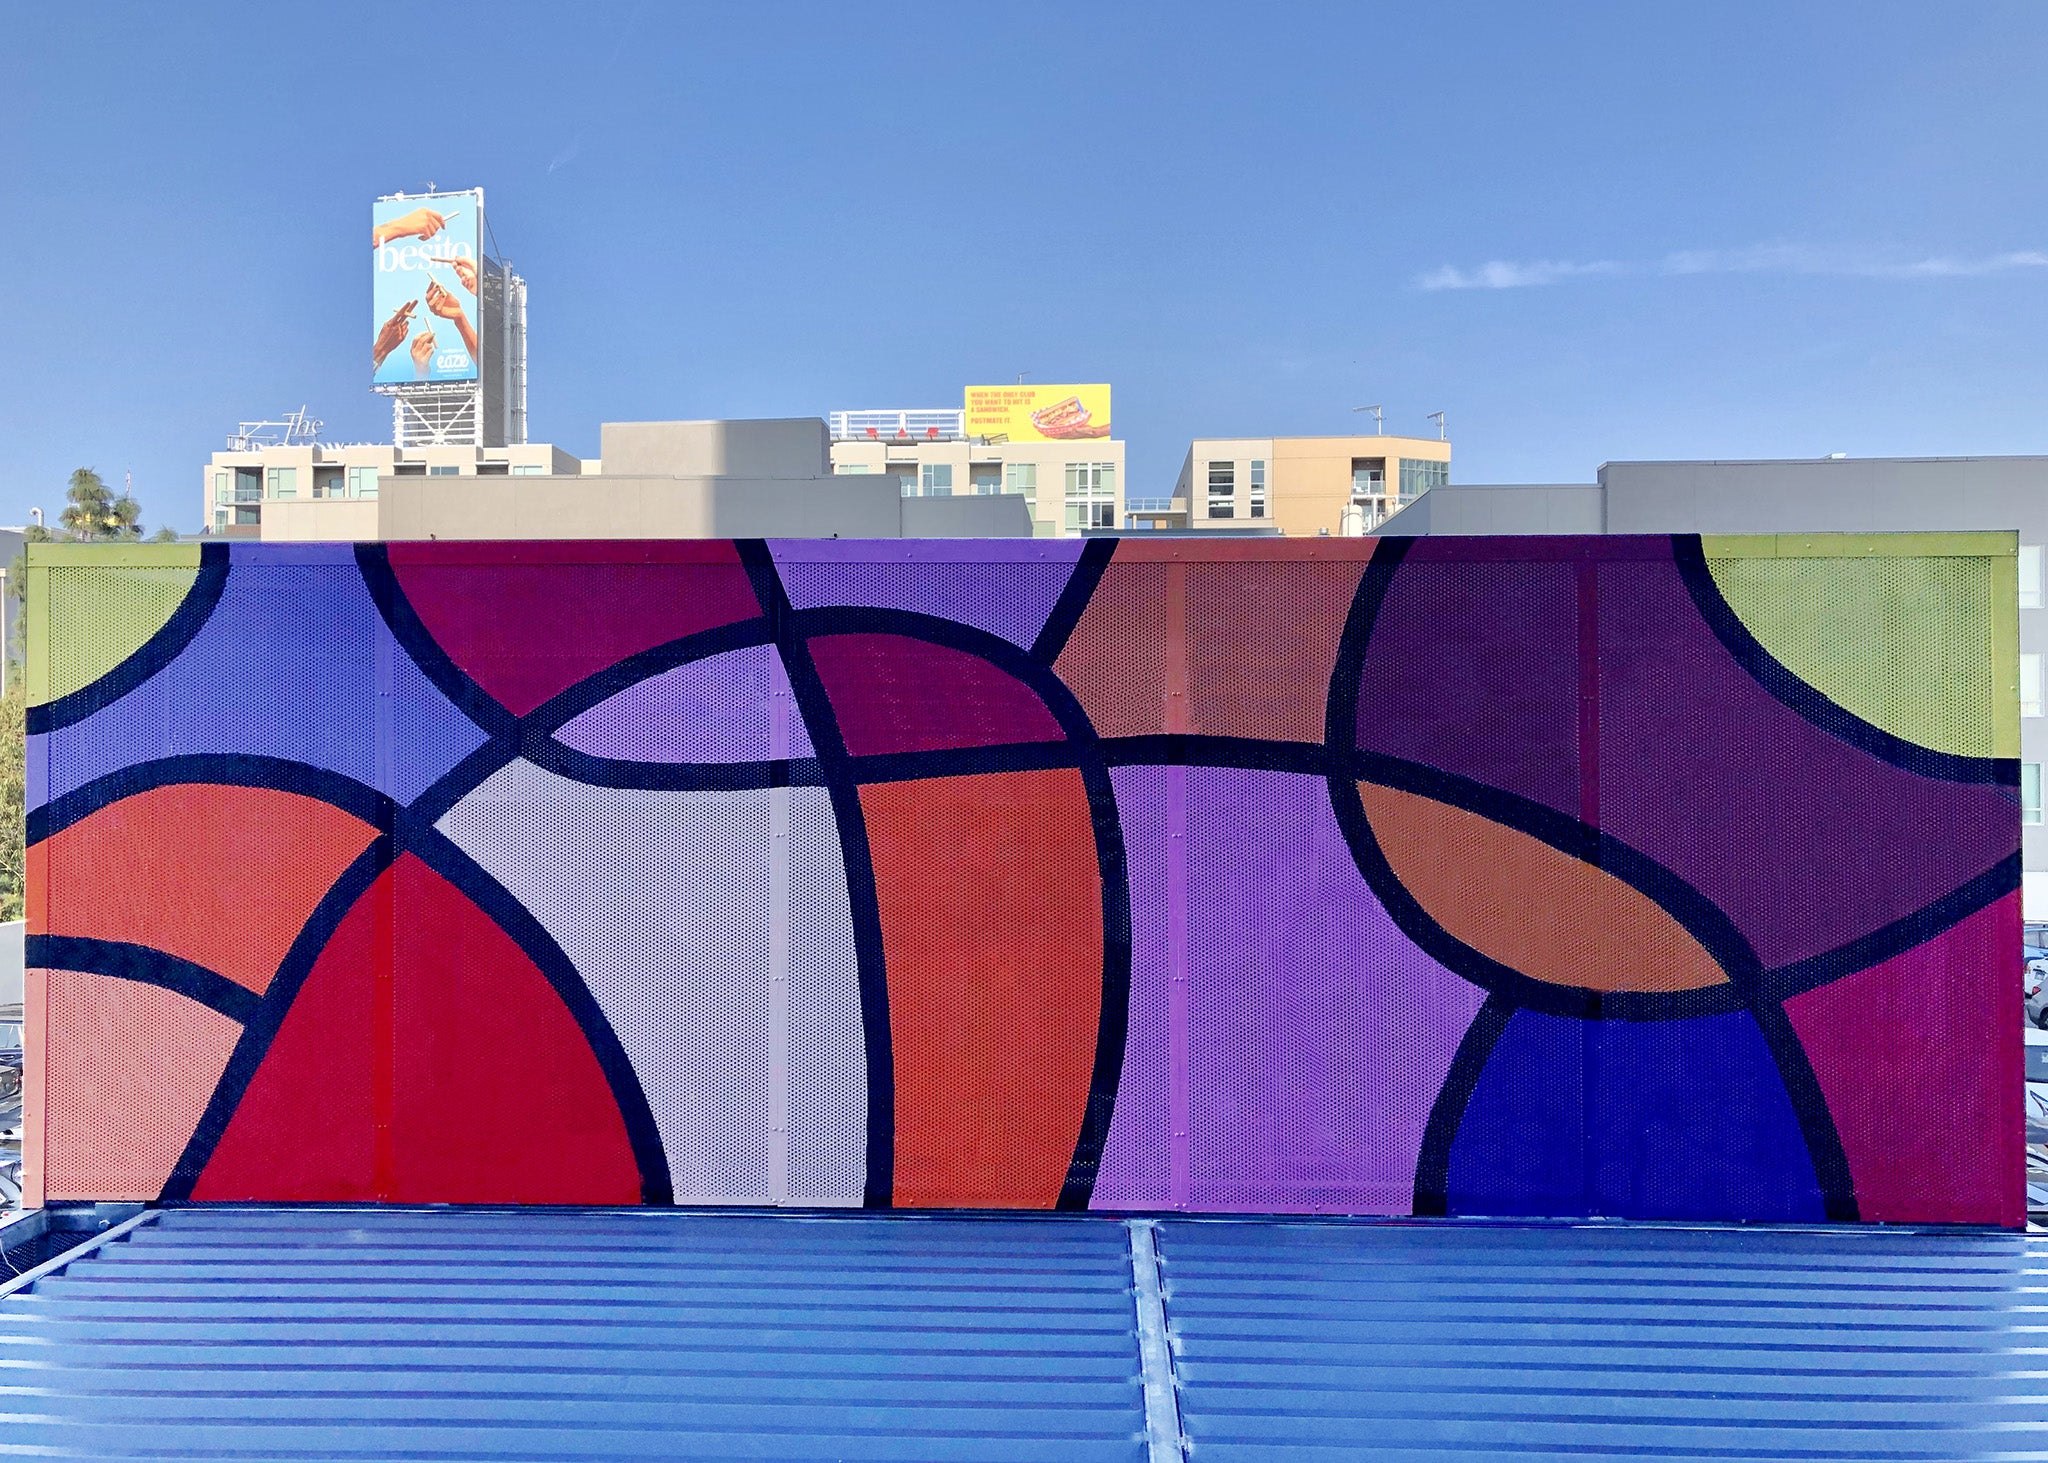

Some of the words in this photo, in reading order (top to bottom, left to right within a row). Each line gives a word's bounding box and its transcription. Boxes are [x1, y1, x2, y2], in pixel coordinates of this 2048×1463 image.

[378, 235, 472, 272] besito
[436, 354, 470, 369] eaze
[282, 404, 324, 441] The
